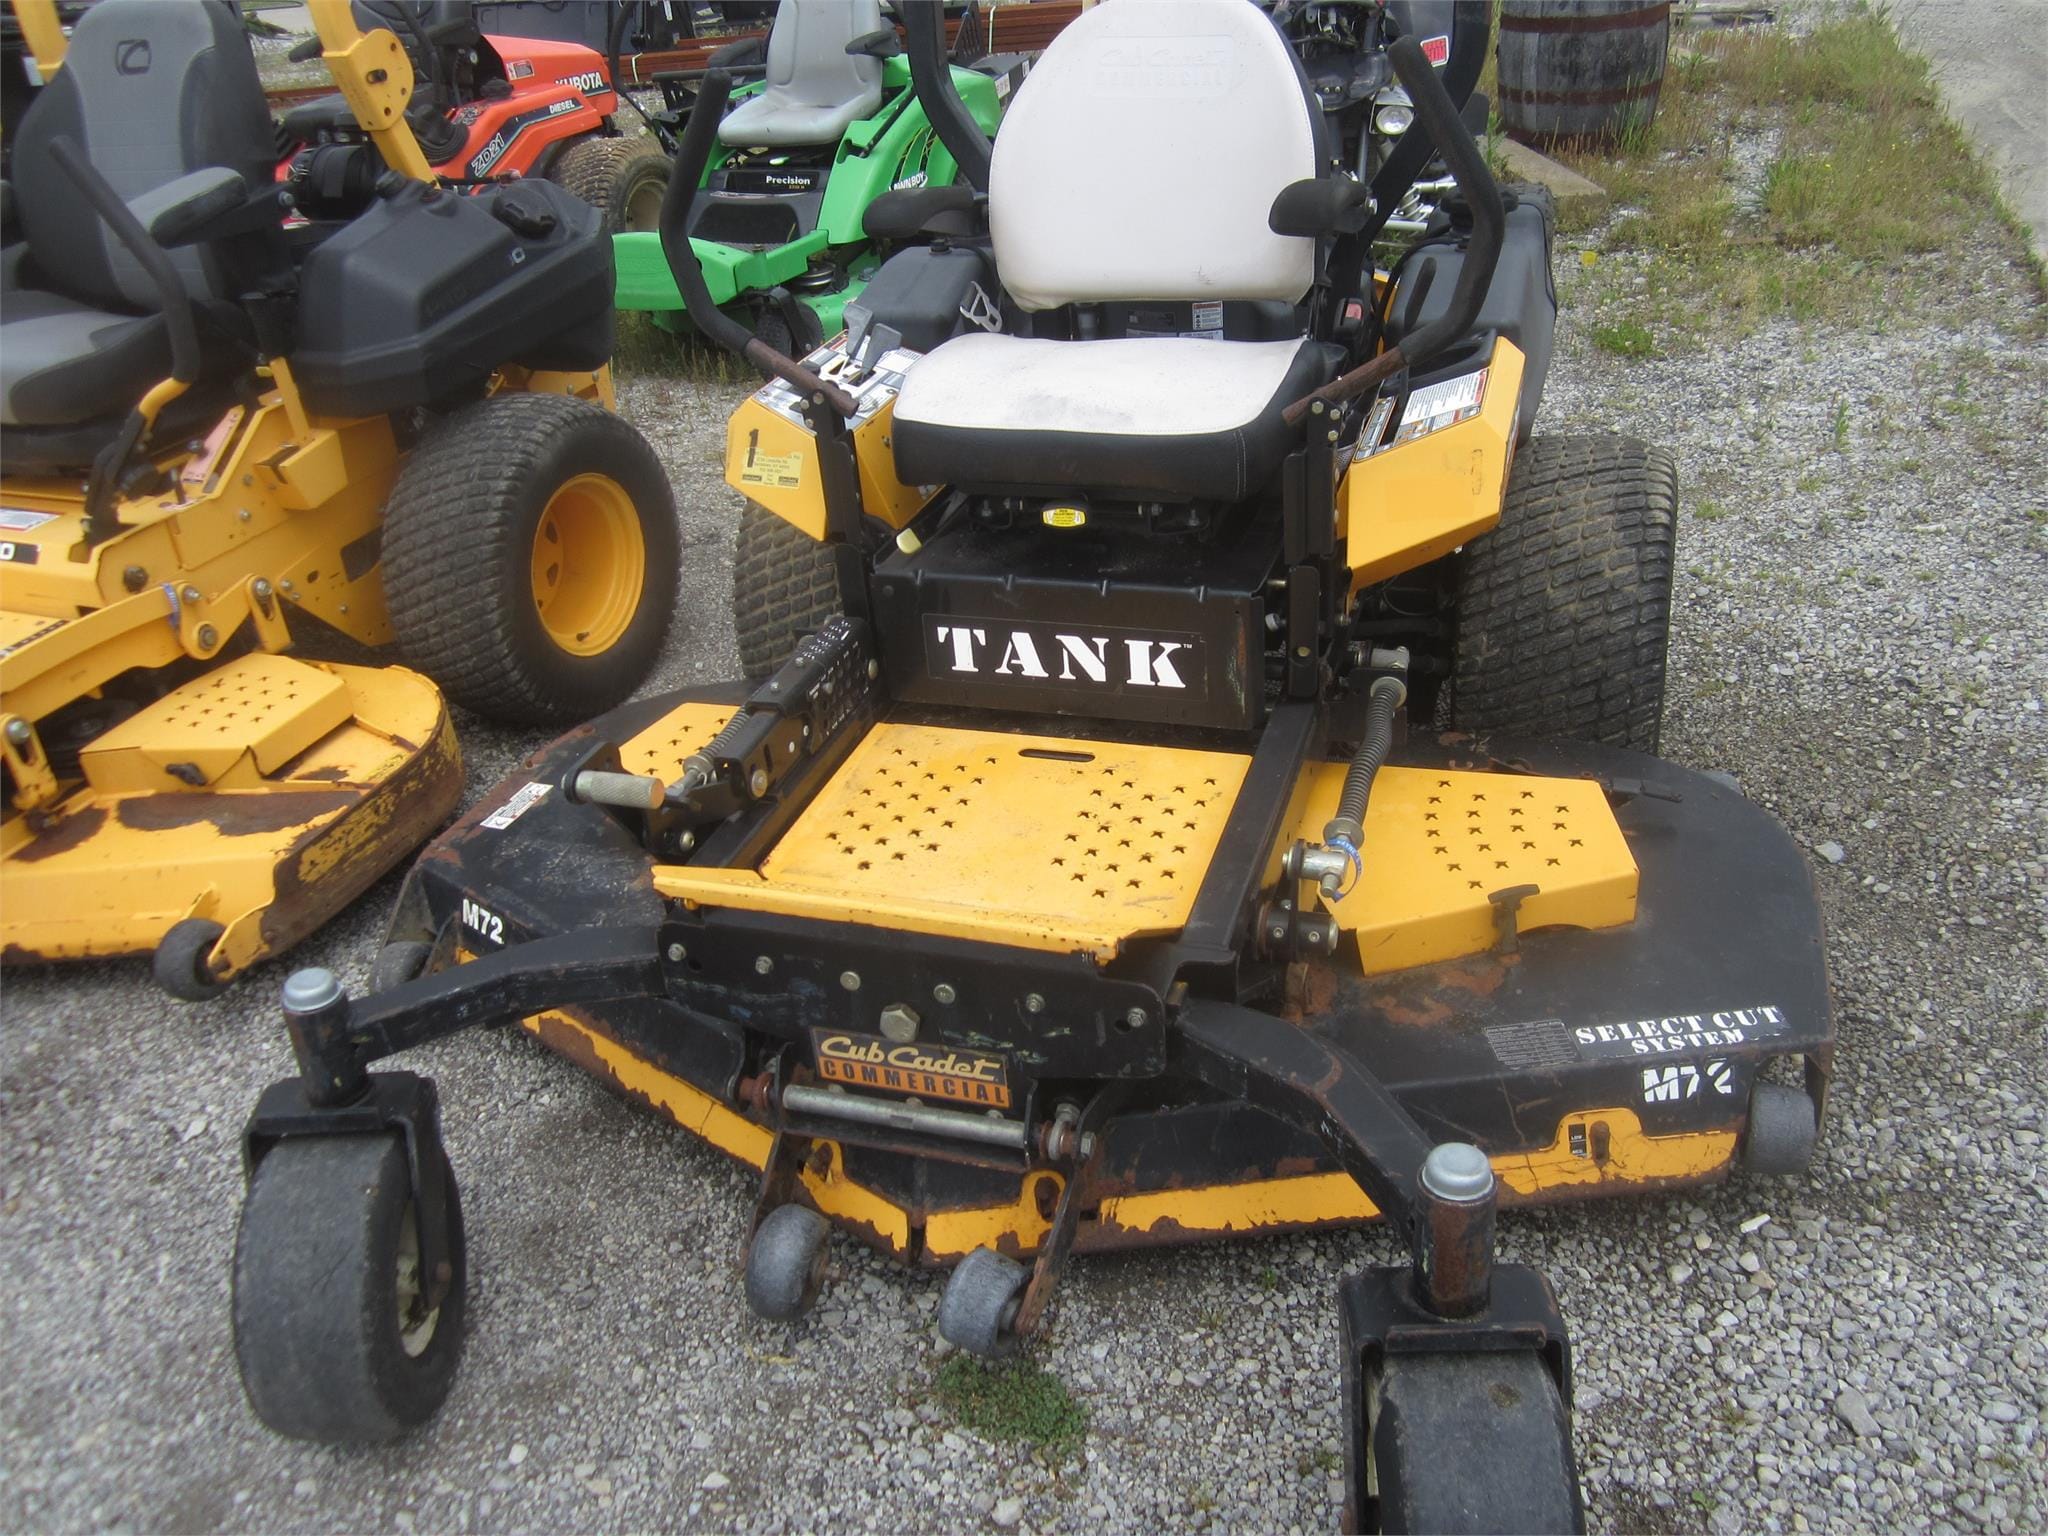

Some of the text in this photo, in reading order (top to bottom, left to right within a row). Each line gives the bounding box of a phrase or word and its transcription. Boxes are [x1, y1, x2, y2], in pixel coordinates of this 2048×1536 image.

[550, 100, 575, 113] DIESEL
[472, 132, 504, 177] ZD21
[766, 175, 811, 185] Precision
[936, 626, 1187, 689] TANK
[462, 898, 504, 945] M72
[1575, 1014, 1703, 1045] SELECT
[1711, 1005, 1779, 1033] CUT
[1631, 1027, 1745, 1055] SYSTEM
[821, 1036, 1001, 1082] Cub Cadet
[823, 1059, 1006, 1104] COMMERCIAL
[1643, 1057, 1733, 1103] M72
